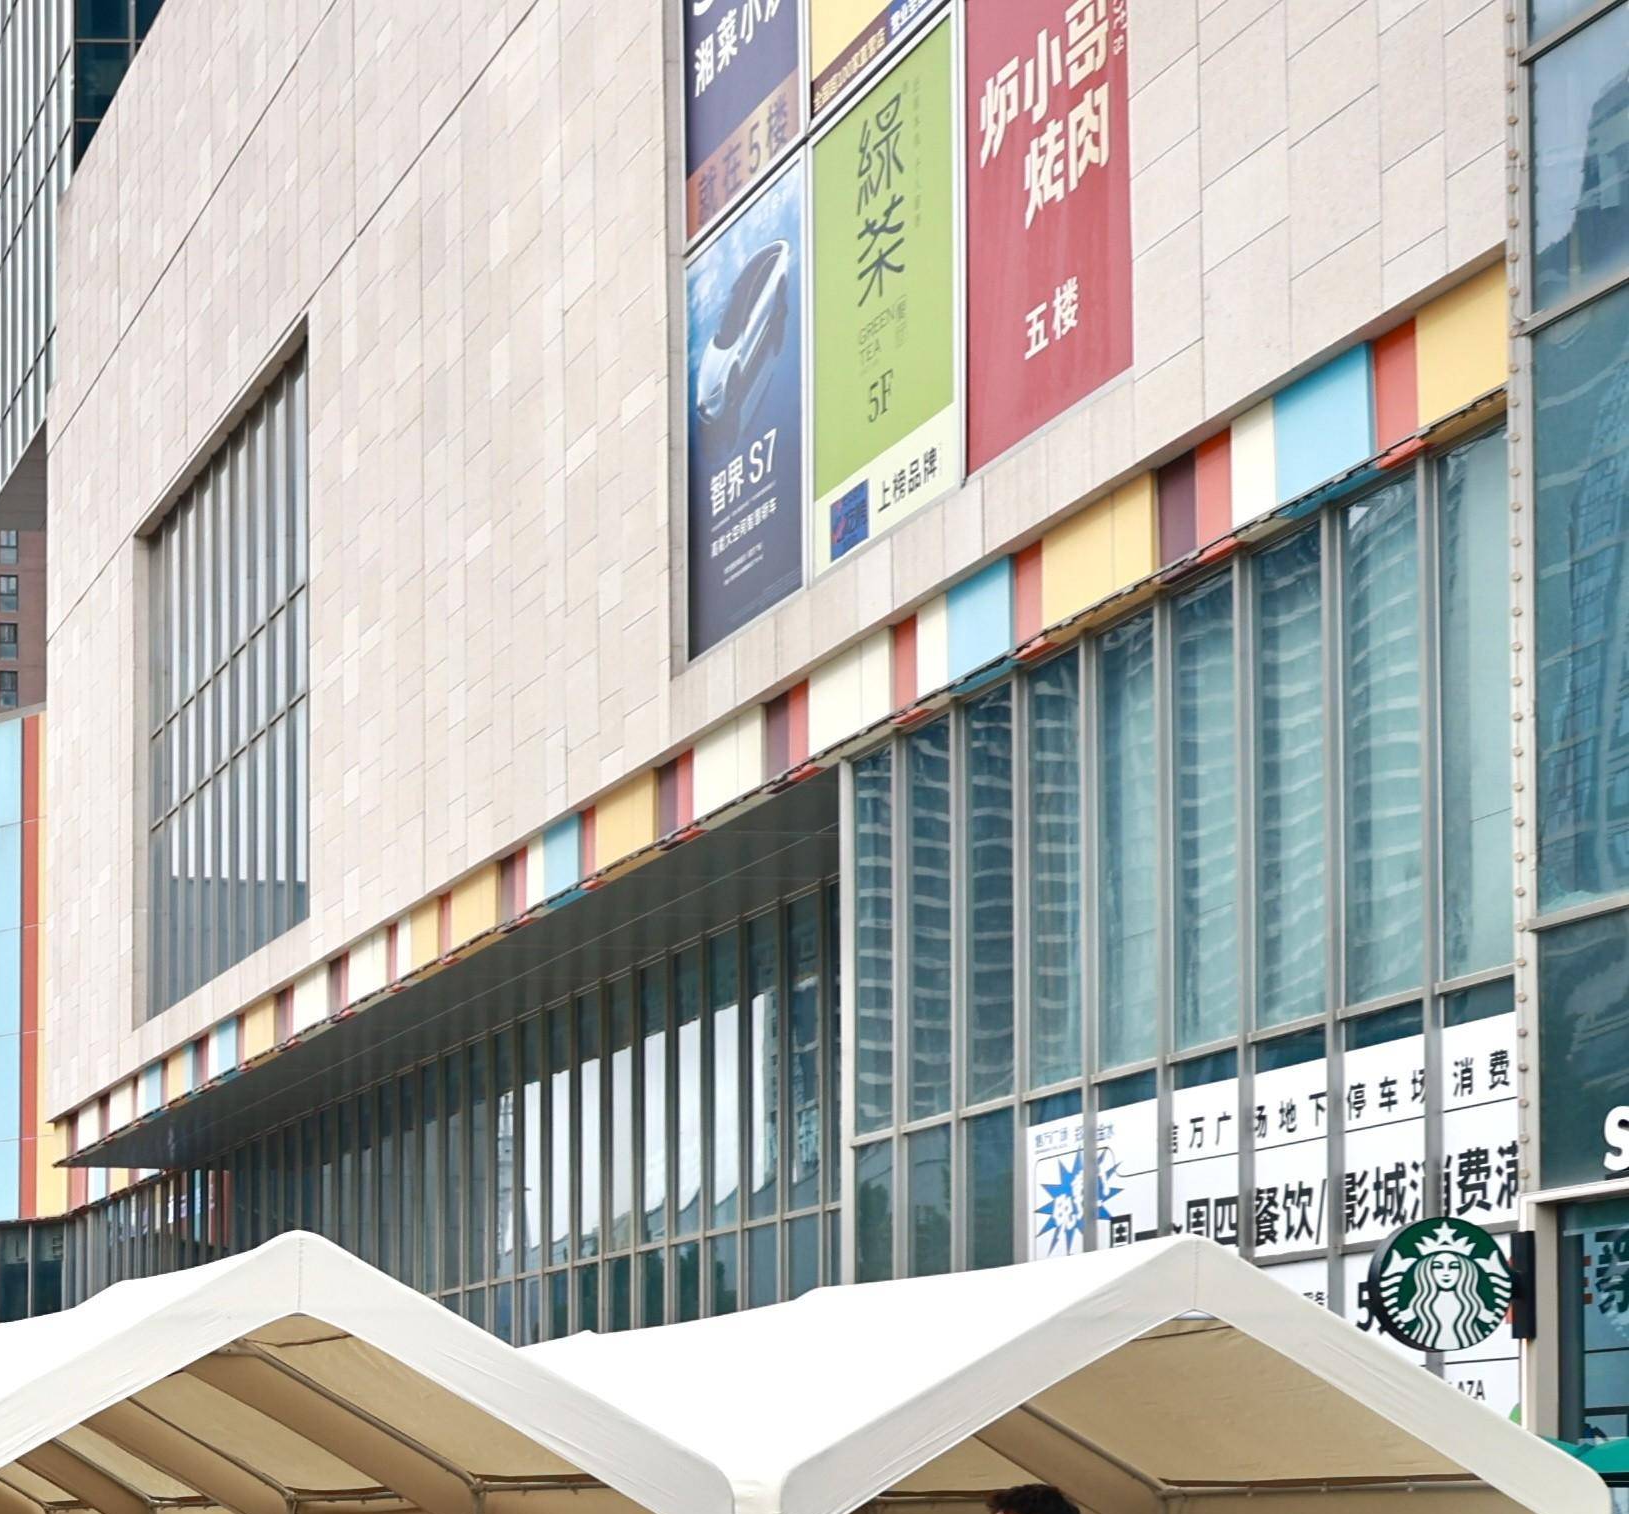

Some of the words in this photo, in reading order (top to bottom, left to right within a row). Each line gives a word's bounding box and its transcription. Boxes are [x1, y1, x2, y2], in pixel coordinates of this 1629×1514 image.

[980, 0, 1109, 169] 炉小哥
[1024, 82, 1109, 230] 烤肉
[1024, 276, 1078, 360] 五楼
[868, 368, 894, 423] 5F
[710, 455, 745, 516] 智界
[749, 428, 777, 484] S7
[878, 446, 938, 513] 上榜品牌
